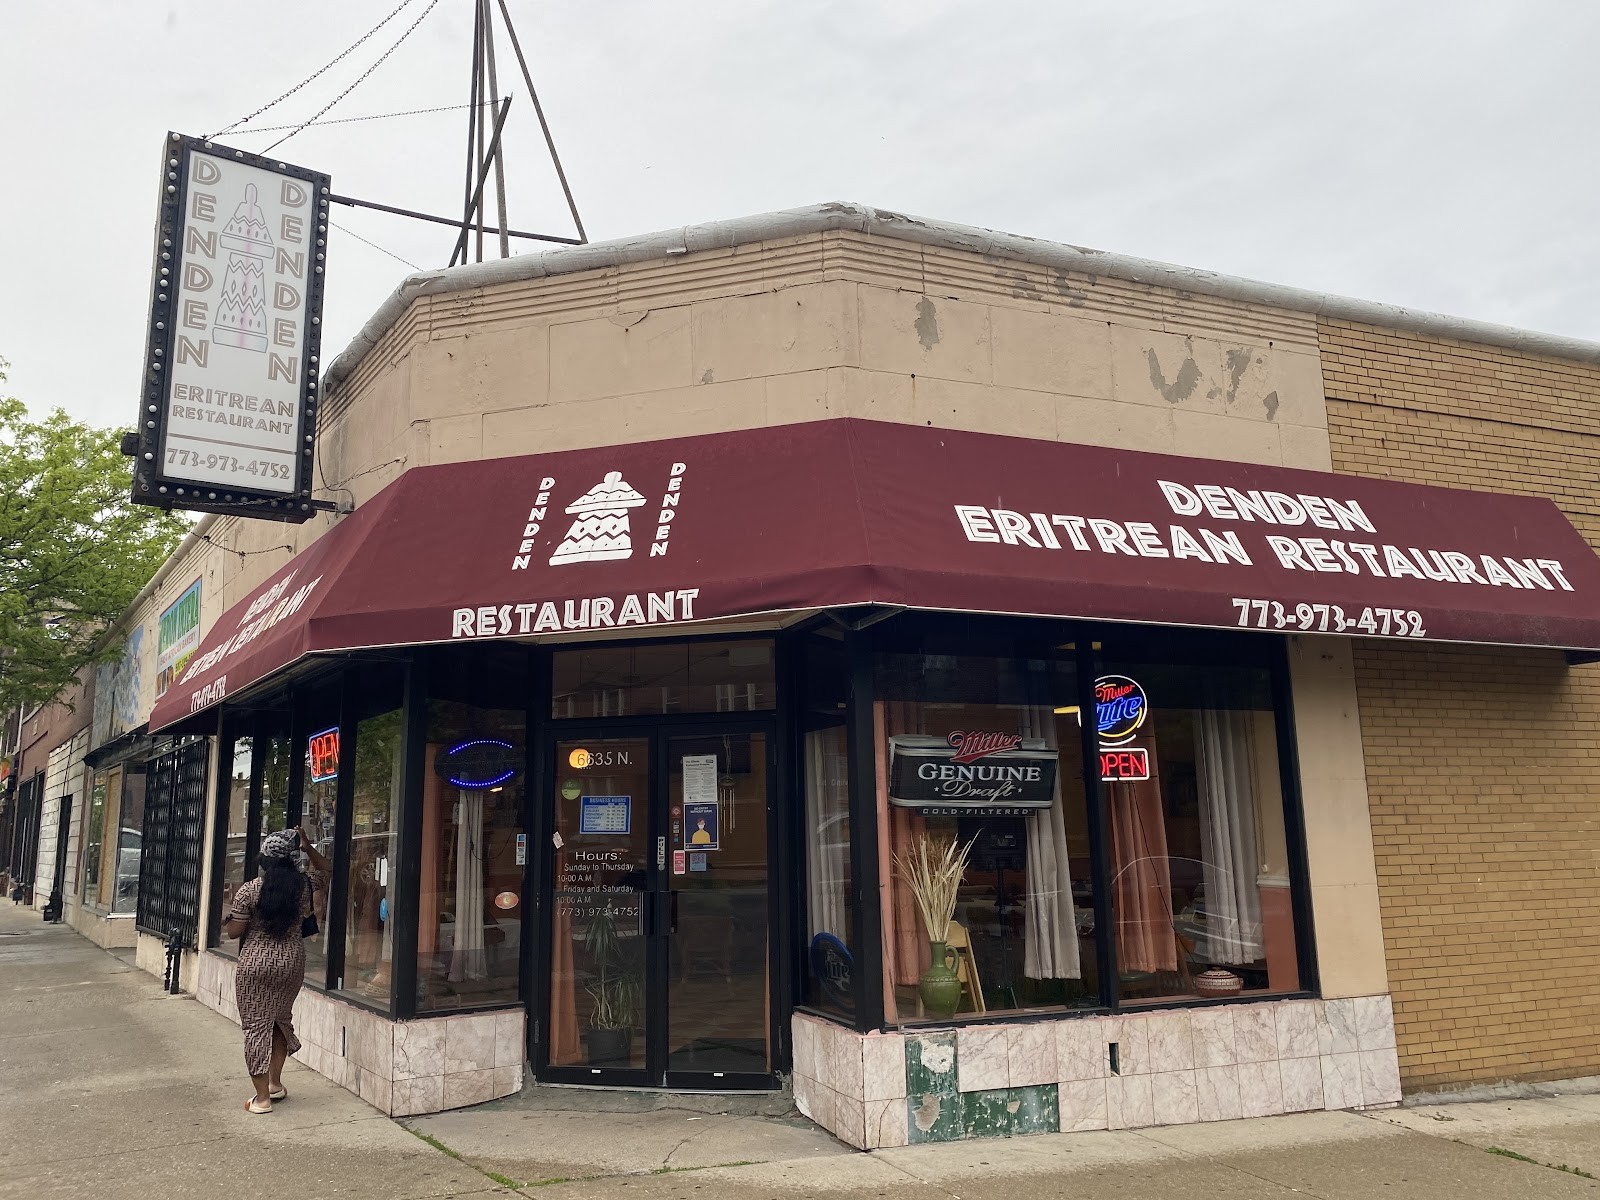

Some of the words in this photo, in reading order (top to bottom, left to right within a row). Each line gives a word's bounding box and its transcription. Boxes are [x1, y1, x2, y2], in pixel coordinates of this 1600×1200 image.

[176, 155, 222, 369] DENDEN
[268, 179, 307, 385] DENDEN
[173, 383, 294, 418] ERITREAN
[172, 405, 293, 435] RESTAURANT
[167, 447, 290, 480] 773-973-4752
[649, 462, 687, 557] DENDEN
[1156, 480, 1377, 533] DENDEN
[511, 477, 556, 570] DENDEN
[953, 505, 1254, 566] ERITREAN
[1265, 535, 1575, 592] RESTAURANT
[451, 588, 700, 638] RESTAURANT
[1232, 597, 1426, 638] 773-973-4752
[1095, 684, 1136, 703] Miller
[1096, 697, 1143, 724] ite
[311, 733, 340, 777] OPEN
[577, 751, 613, 766] 6635
[617, 751, 633, 765] N.
[947, 730, 1023, 763] Miller
[917, 763, 1042, 783] GENUINE
[941, 778, 1016, 803] Draft
[564, 863, 591, 872] Sunday
[592, 863, 600, 871] to
[601, 862, 634, 872] Thursday
[575, 851, 622, 861] Hours:
[563, 885, 586, 894] Friday
[586, 885, 600, 893] and
[602, 884, 634, 894] Saturday
[588, 907, 639, 917] 973-4752
